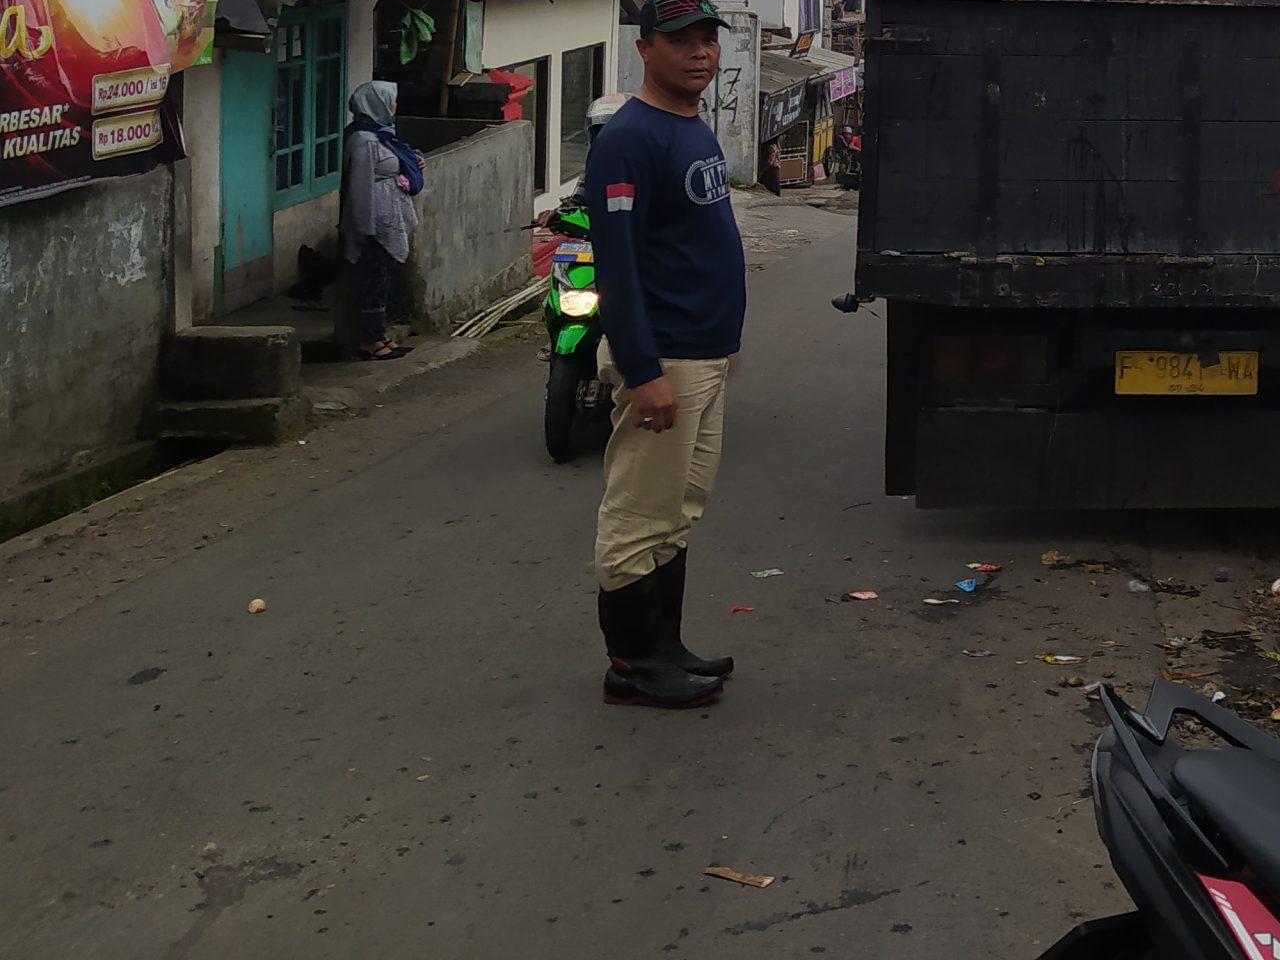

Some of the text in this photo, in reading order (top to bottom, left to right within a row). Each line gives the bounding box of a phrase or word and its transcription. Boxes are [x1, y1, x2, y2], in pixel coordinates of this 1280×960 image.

[159, 76, 167, 90] 16
[3, 126, 82, 159] KUALITAS
[98, 132, 108, 146] Rp
[110, 123, 151, 145] 18.000
